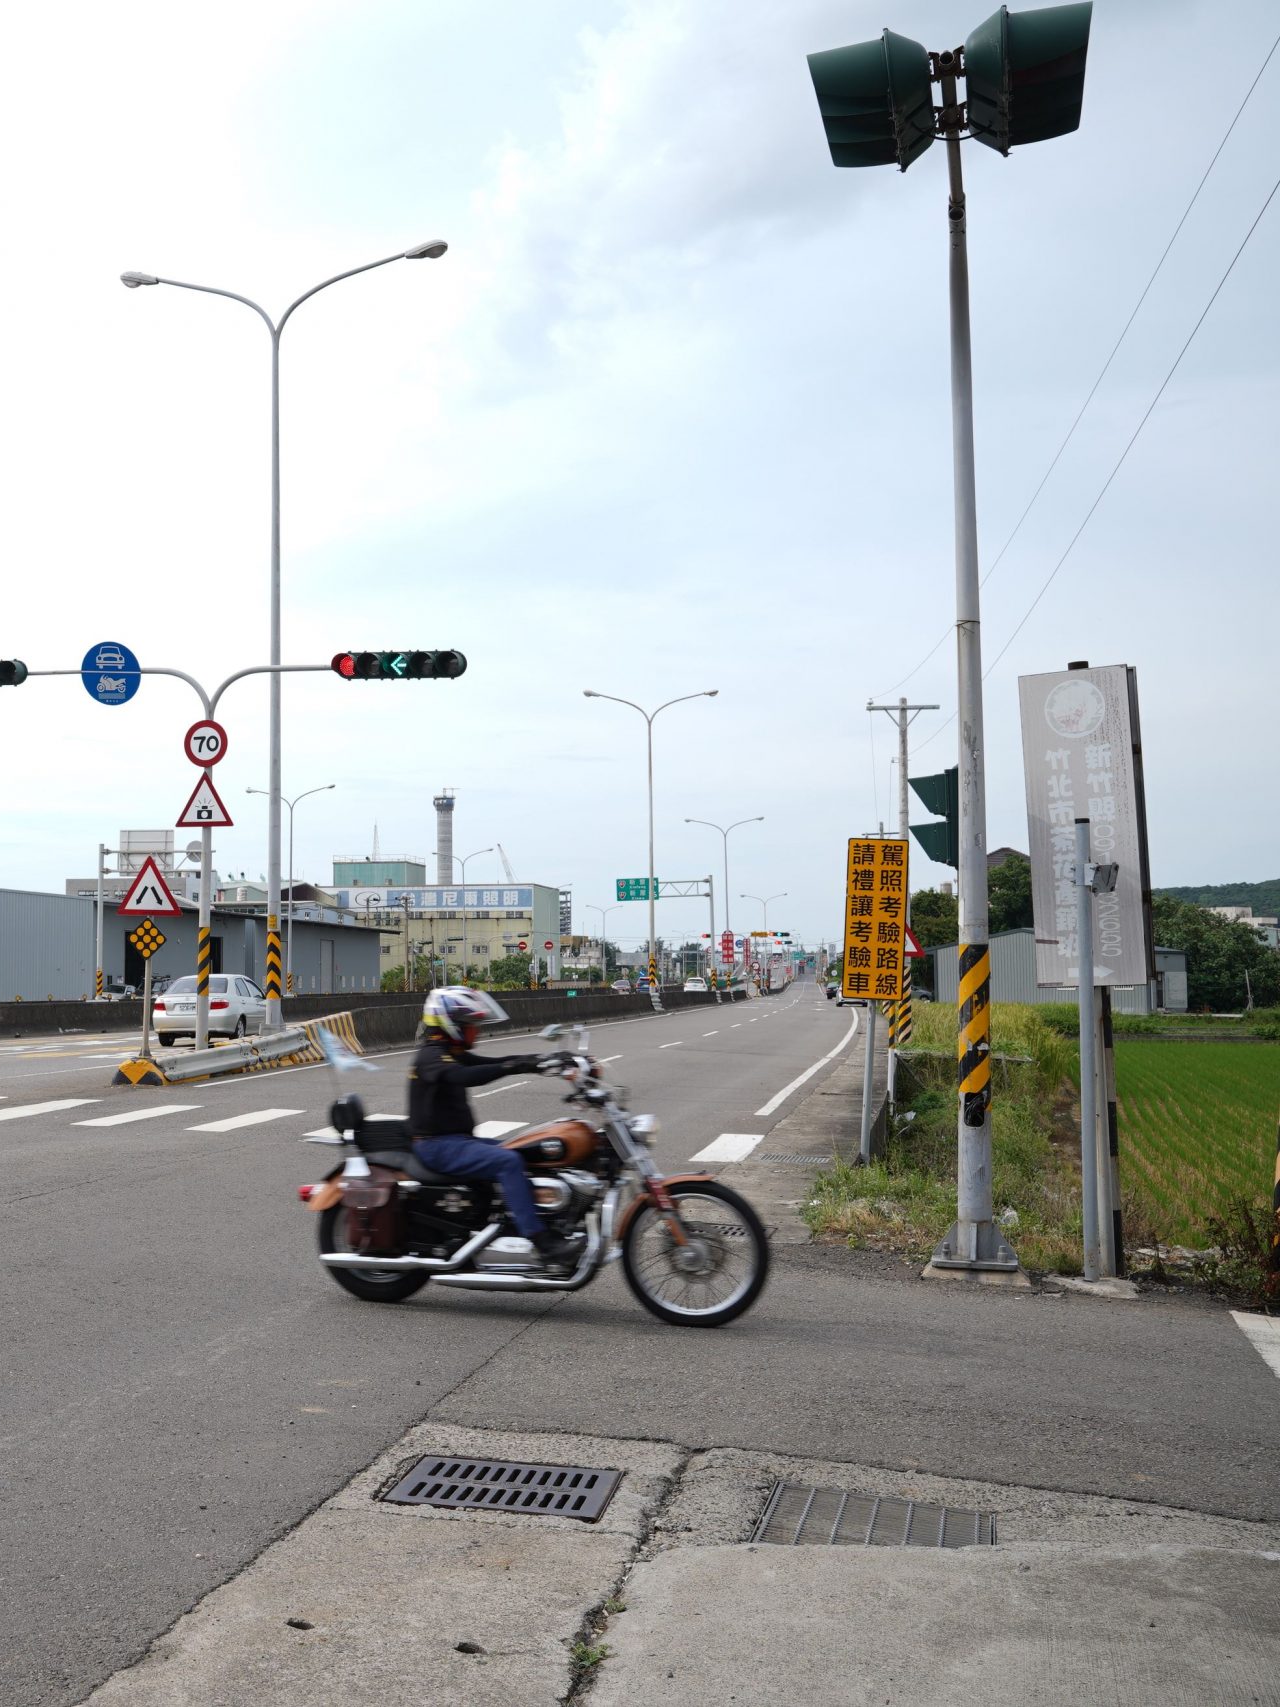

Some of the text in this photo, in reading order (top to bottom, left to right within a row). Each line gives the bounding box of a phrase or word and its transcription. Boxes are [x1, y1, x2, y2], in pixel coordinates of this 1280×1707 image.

[193, 735, 219, 753] 70
[1085, 744, 1115, 822] 新竹縣
[847, 843, 876, 995] 請禮讓考驗車
[875, 843, 904, 996] 駕照考驗路線
